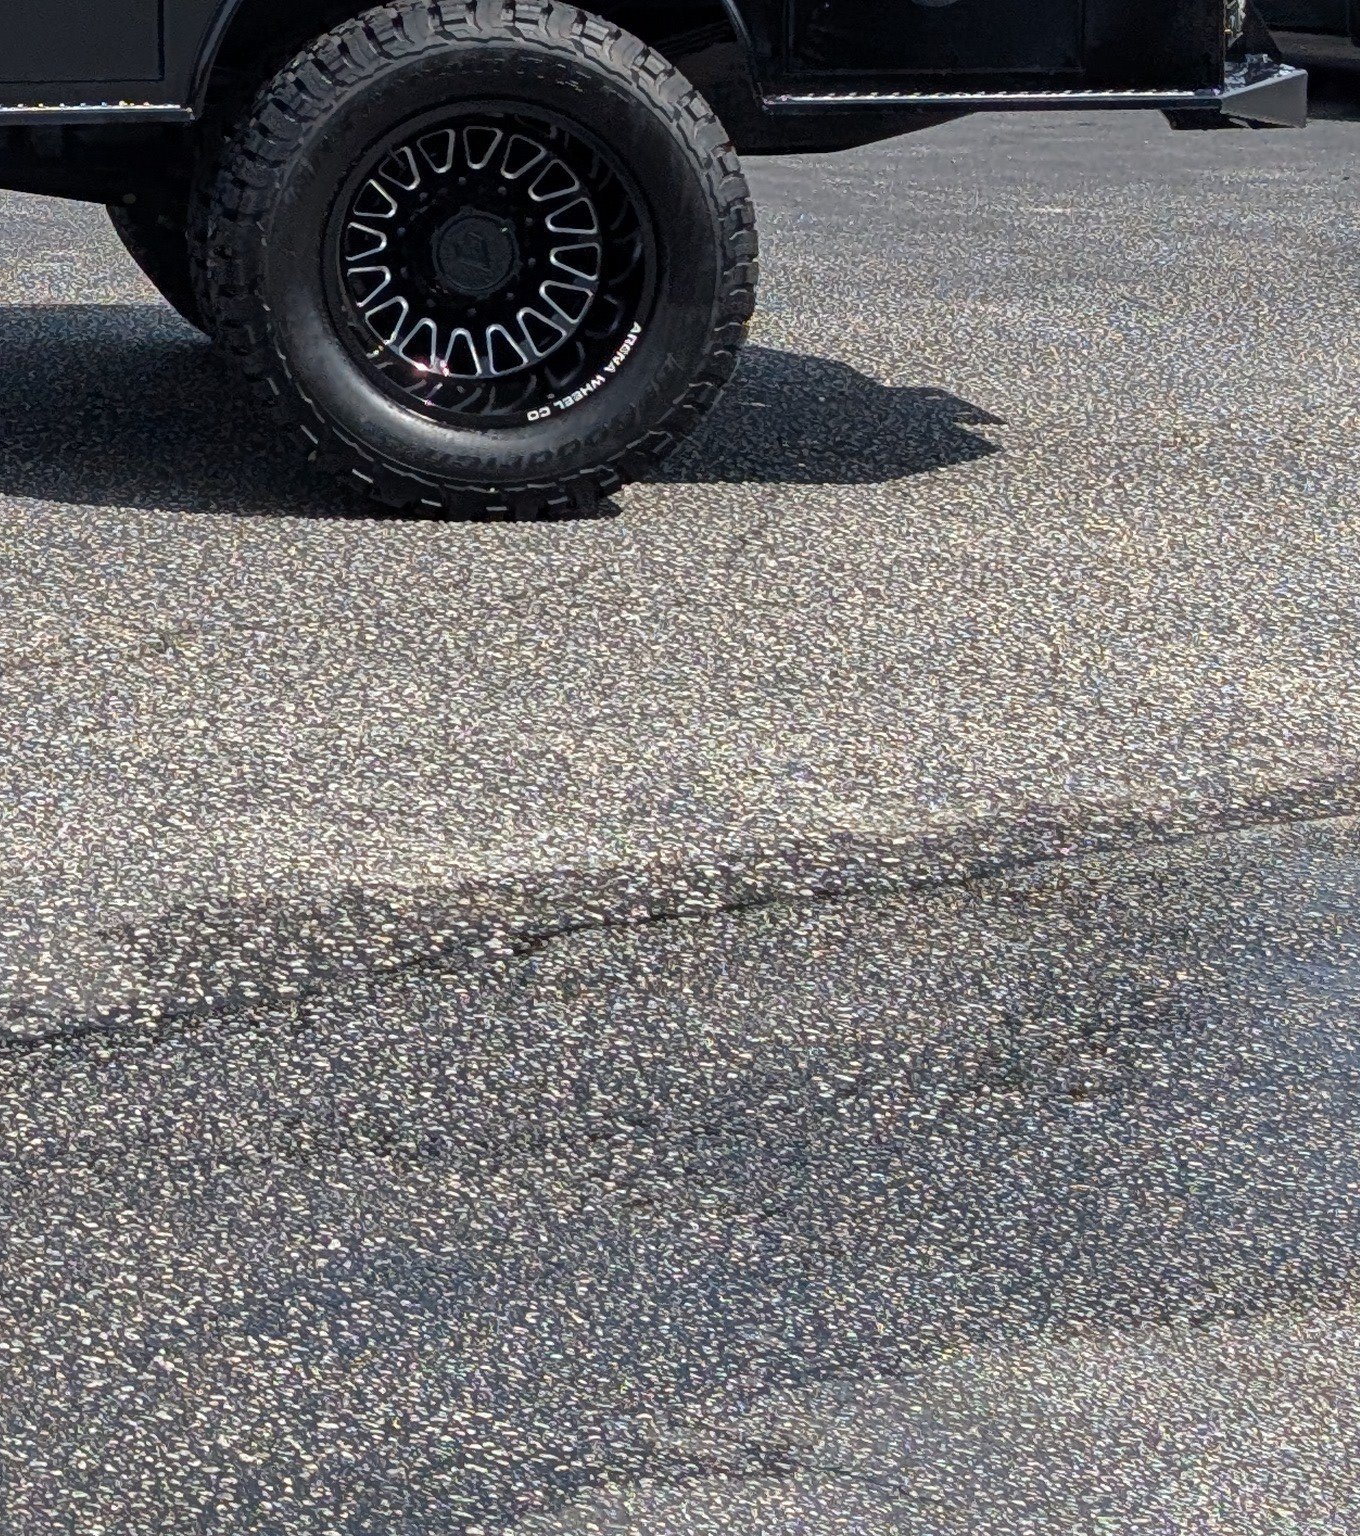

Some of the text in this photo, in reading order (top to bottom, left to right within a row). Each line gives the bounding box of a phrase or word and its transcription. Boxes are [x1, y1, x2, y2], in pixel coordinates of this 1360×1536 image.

[526, 321, 641, 421] ARENA WHEEL CO
